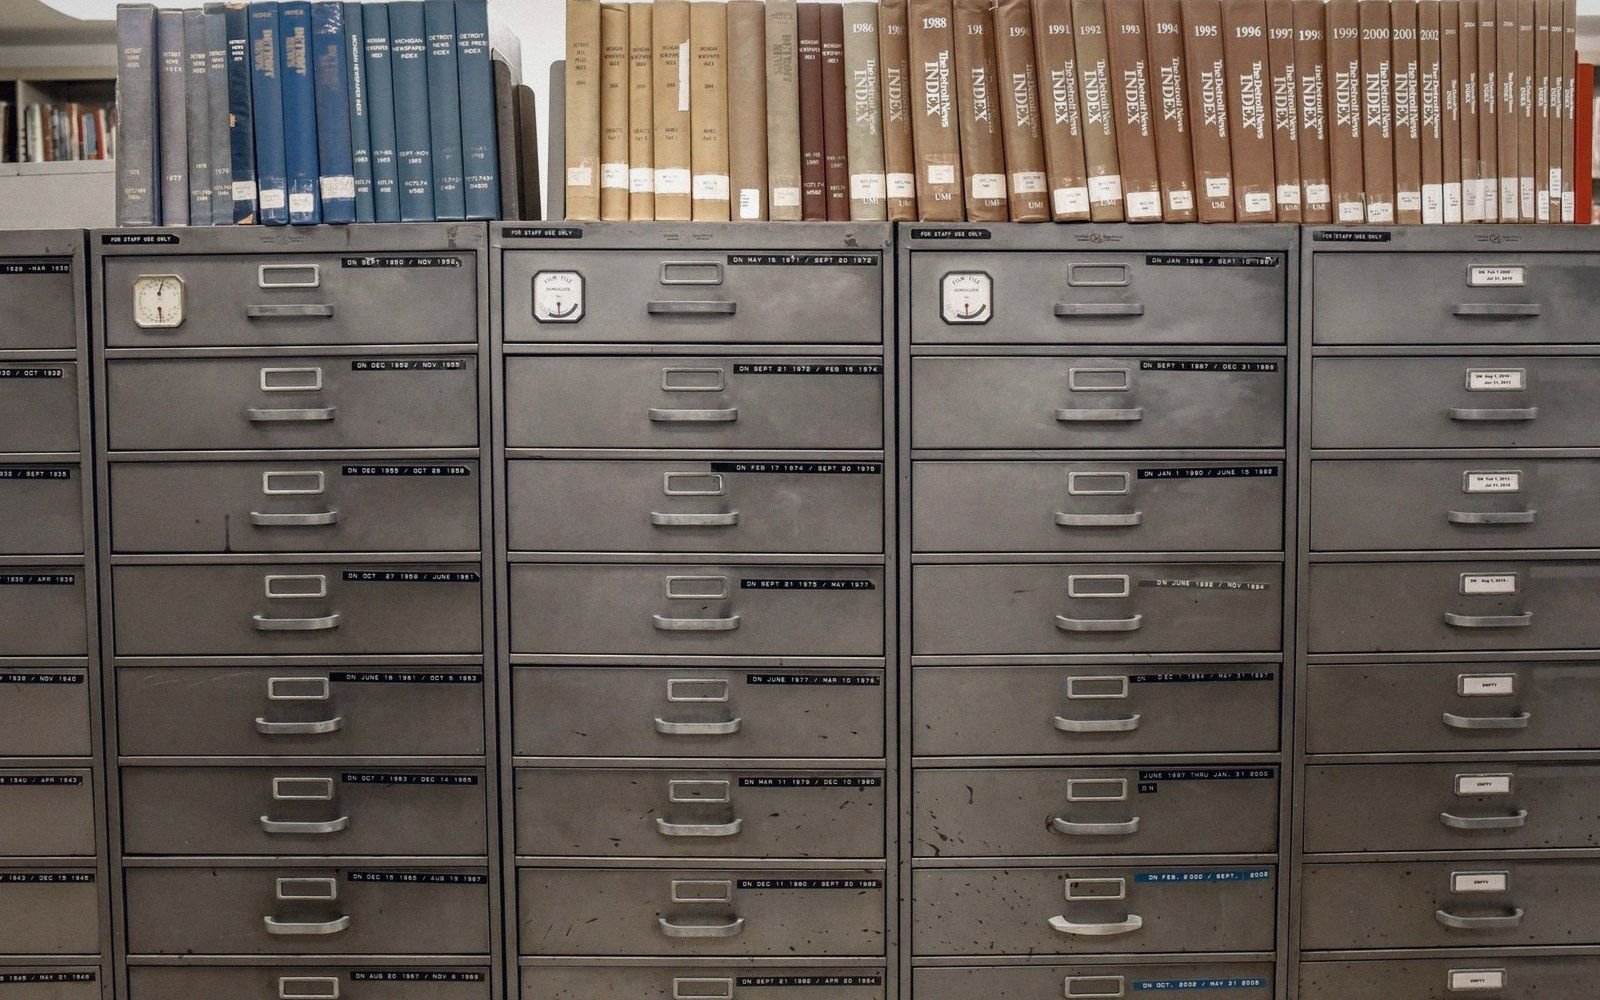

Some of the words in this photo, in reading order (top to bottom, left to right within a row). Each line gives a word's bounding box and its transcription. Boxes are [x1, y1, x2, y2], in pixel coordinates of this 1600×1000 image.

[852, 23, 873, 33] 1986
[923, 18, 947, 29] 1988
[1048, 25, 1070, 34] 1991
[1080, 26, 1102, 35] 1992
[1121, 25, 1140, 34] 1993
[1157, 23, 1178, 34] 1994
[1195, 26, 1217, 36] 1995
[1236, 27, 1261, 38] 1996
[1270, 28, 1293, 39] 1997
[1334, 28, 1358, 38] 1999
[1363, 29, 1389, 39] 2000
[1394, 29, 1416, 39] 2001
[1420, 29, 1439, 40] 2002
[939, 50, 948, 68] The
[1253, 60, 1262, 79] The
[1380, 60, 1389, 79] The
[1408, 61, 1417, 79] The
[854, 70, 869, 123] INDEX
[888, 68, 902, 122] INDEX
[925, 62, 940, 116] INDEX
[940, 69, 949, 102] Detroit
[972, 68, 988, 122] INDEX
[1052, 70, 1069, 124] INDEX
[1084, 71, 1101, 124] INDEX
[1124, 70, 1140, 124] INDEX
[1138, 78, 1147, 111] Detroit
[1161, 67, 1177, 120] INDEX
[1202, 72, 1216, 125] INDEX
[1255, 80, 1264, 113] Detroit
[1336, 72, 1350, 125] INDEX
[1381, 79, 1389, 113] Detroit
[1409, 80, 1418, 113] Detroit
[1013, 73, 1030, 126] INDEX
[1240, 75, 1256, 128] INDEX
[1274, 76, 1289, 130] INDEX
[1303, 76, 1317, 129] INDEX
[1366, 73, 1381, 126] INDEX
[1395, 73, 1409, 126] INDEX
[1423, 73, 1433, 125] INDEX
[941, 102, 950, 128] News
[1256, 113, 1265, 139] News
[1382, 113, 1390, 138] News
[1410, 113, 1418, 138] News
[544, 276, 557, 284] FILM
[560, 275, 572, 283] FILE
[952, 276, 965, 285] FILM
